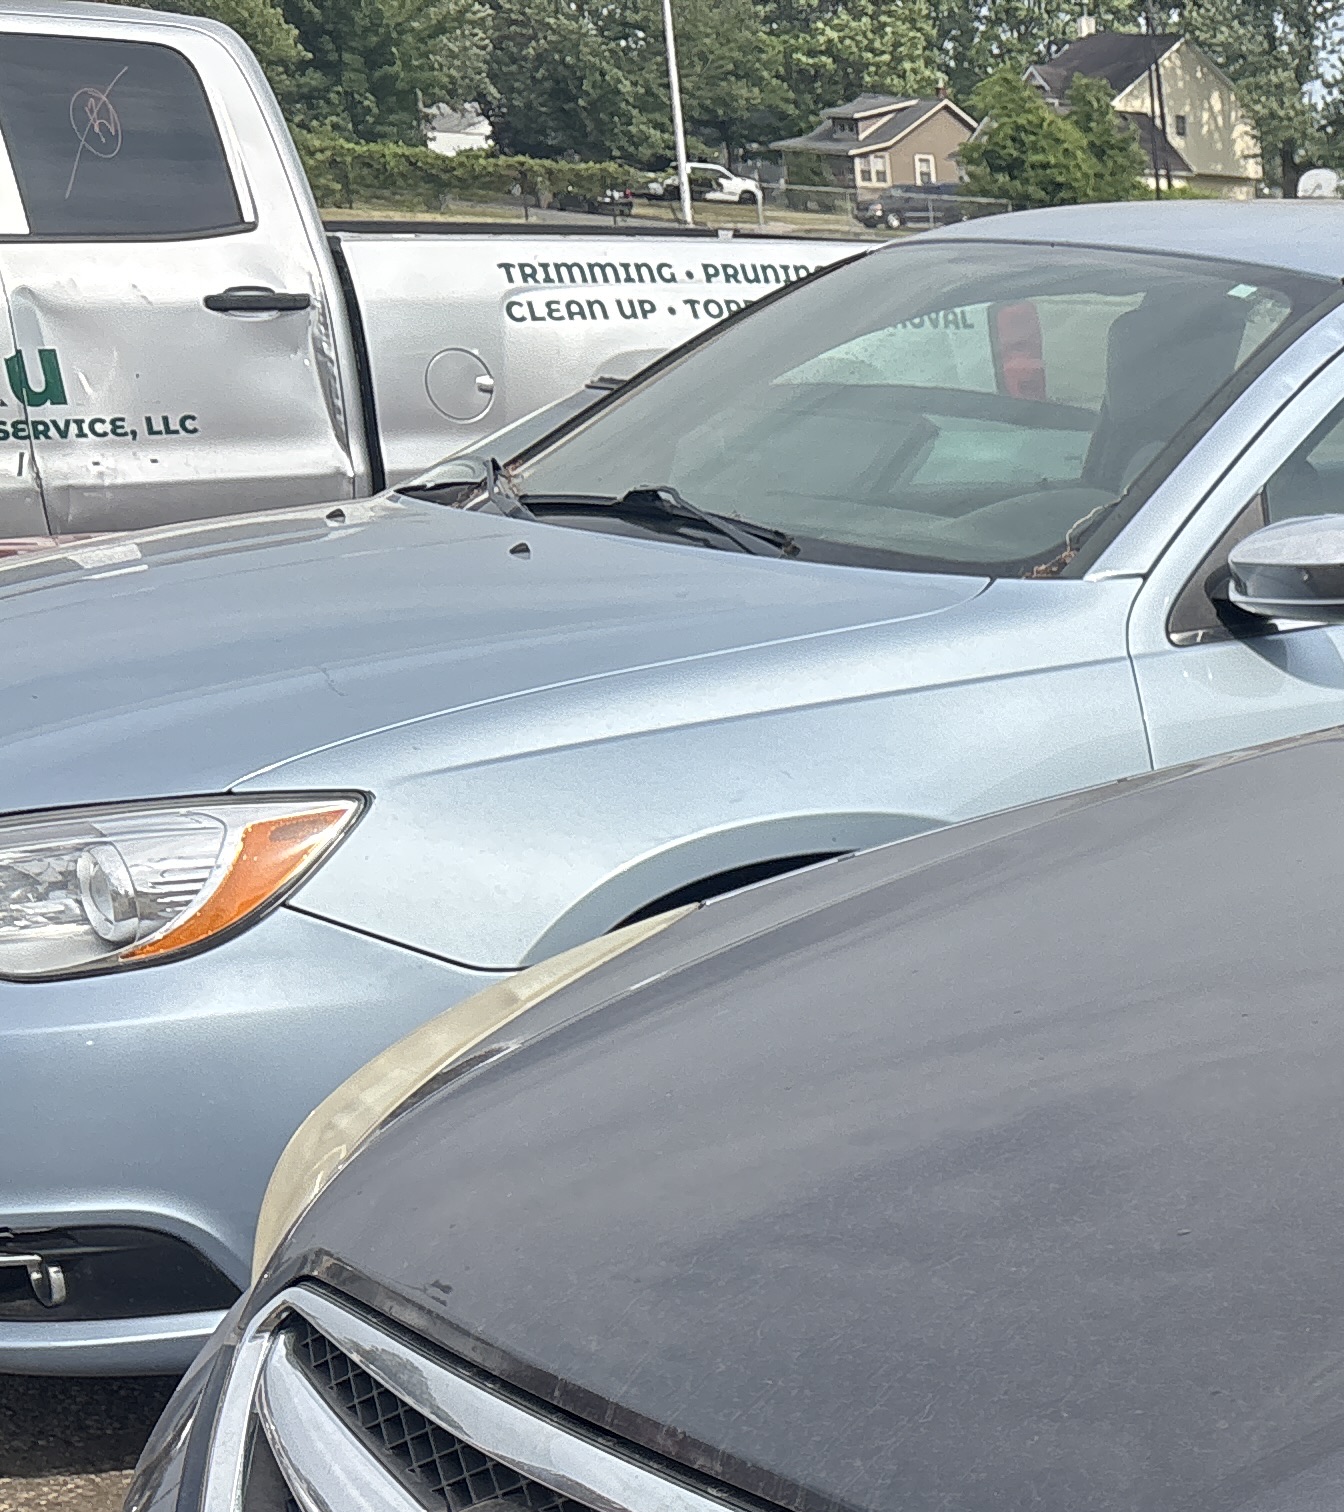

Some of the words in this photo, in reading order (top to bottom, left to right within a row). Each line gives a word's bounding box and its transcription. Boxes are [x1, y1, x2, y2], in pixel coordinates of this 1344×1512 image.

[496, 262, 678, 285] TRIMMING
[701, 262, 824, 285] PRUNIN
[505, 299, 610, 322] CLEAN
[616, 298, 658, 320] UP
[682, 298, 754, 320] TOP
[144, 413, 199, 436] LLC
